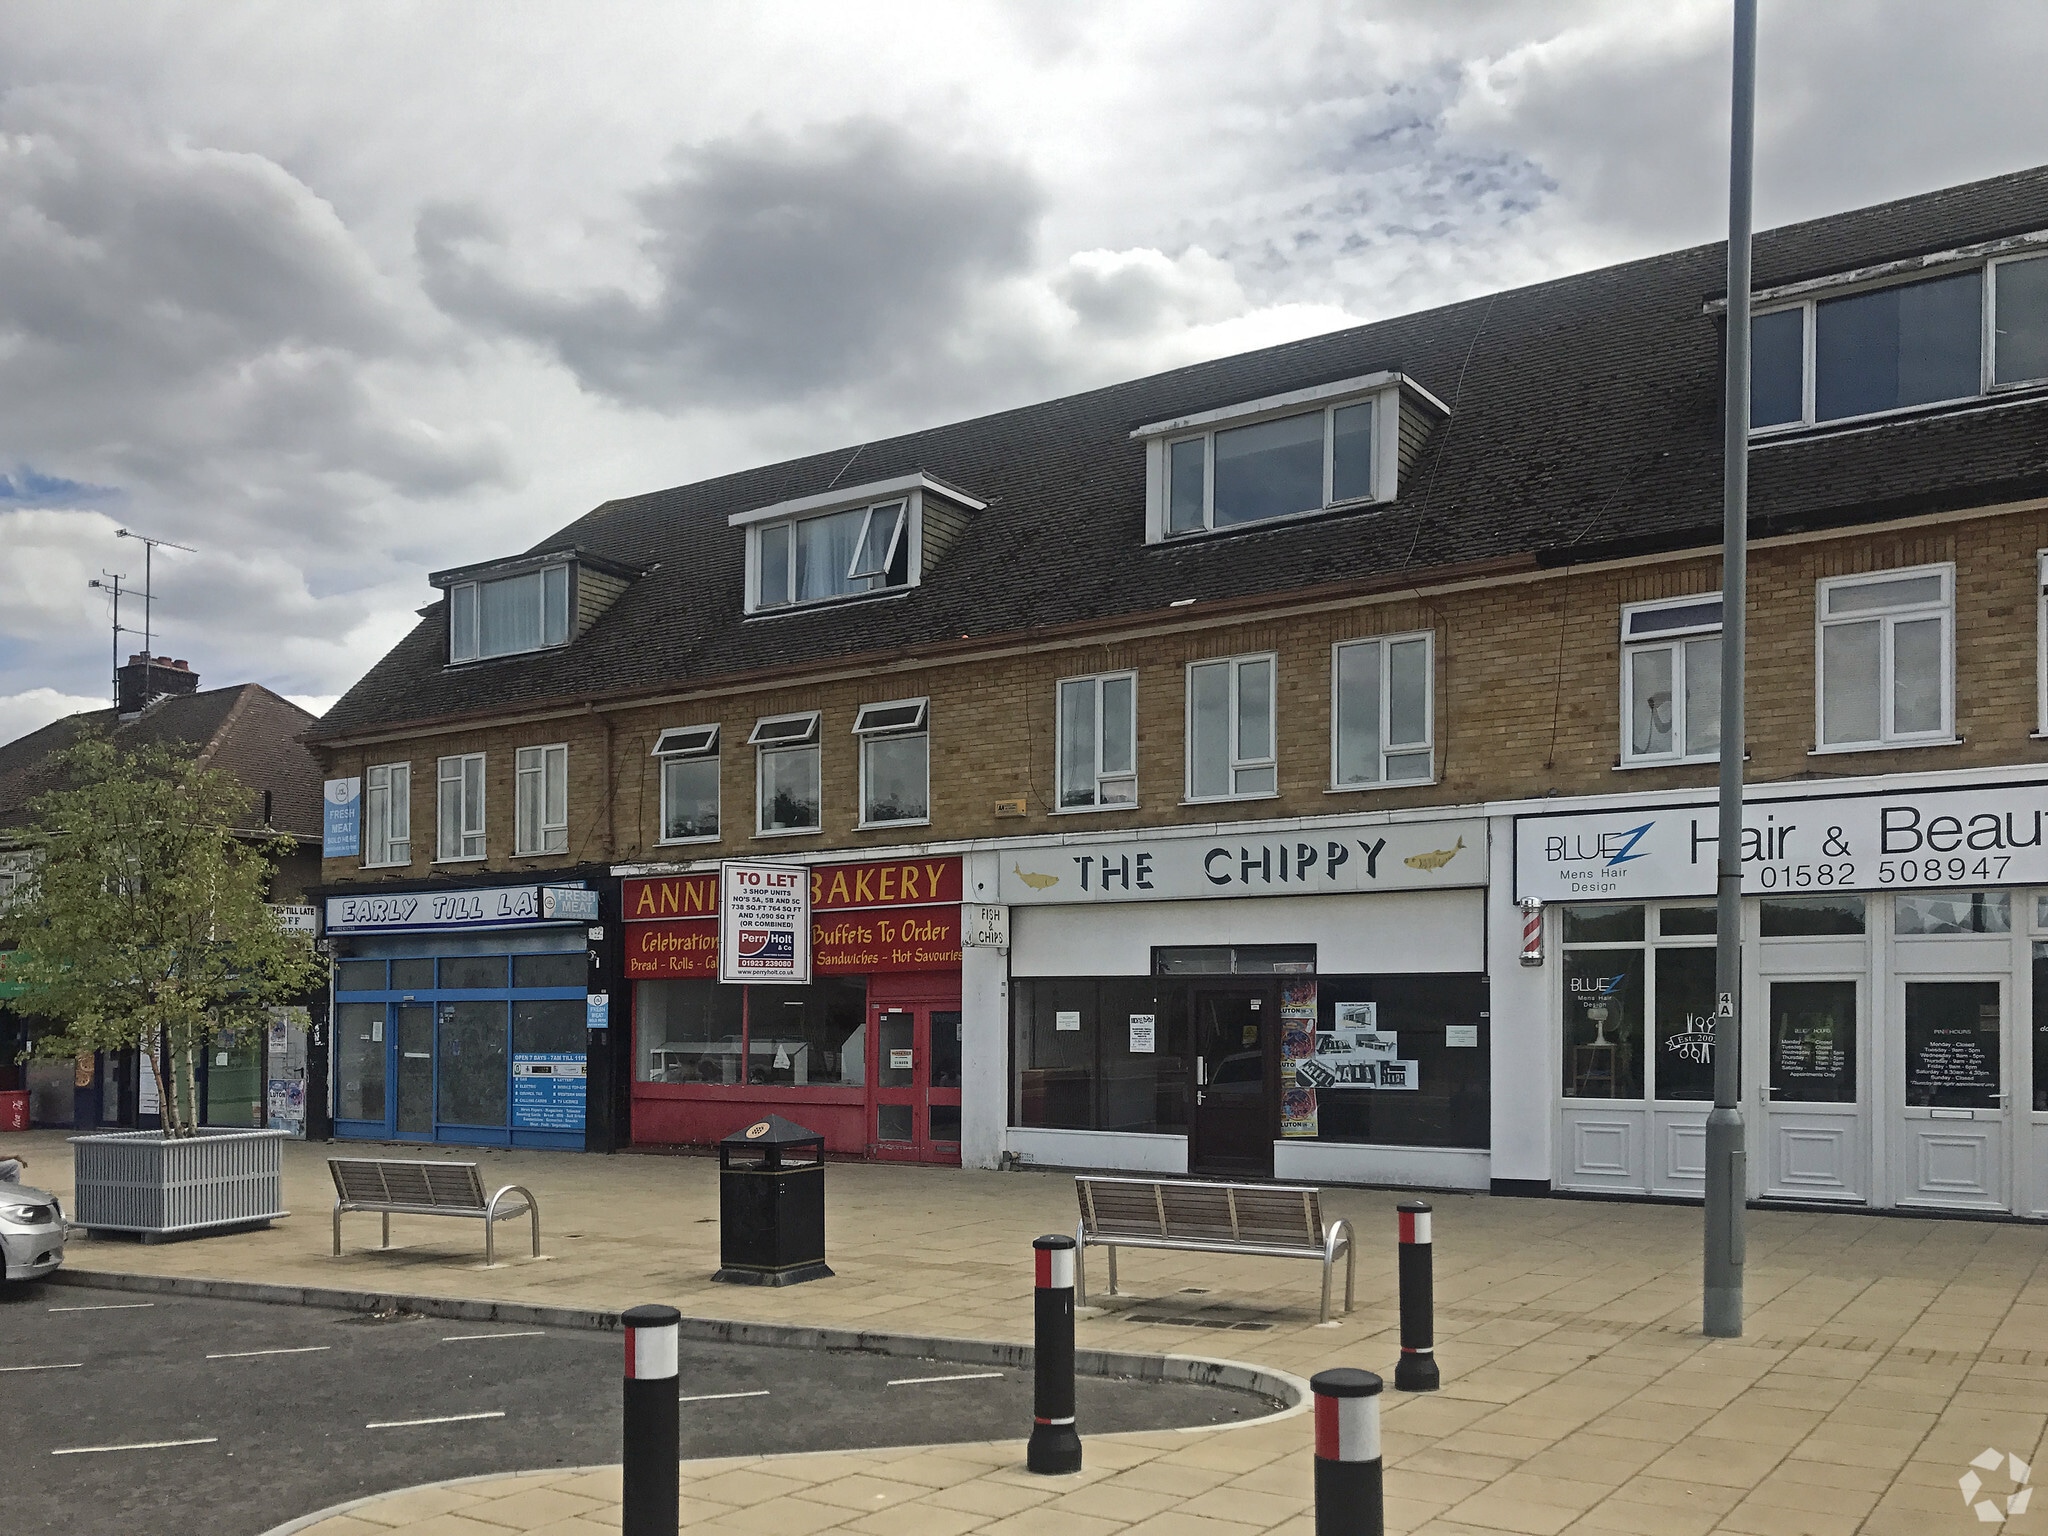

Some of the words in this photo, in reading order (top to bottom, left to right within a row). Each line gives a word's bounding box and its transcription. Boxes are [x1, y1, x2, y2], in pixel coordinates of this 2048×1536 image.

[329, 808, 355, 820] FRESH
[331, 822, 353, 833] MEAT
[1691, 815, 1796, 863] Hair
[1822, 826, 1852, 857] &
[1880, 806, 2048, 854] Beau
[1072, 852, 1154, 891] THE
[1204, 838, 1386, 885] CHIPPY
[1560, 869, 1594, 880] Mens
[1601, 868, 1628, 878] Hair
[1761, 863, 1855, 888] 01582
[1878, 856, 2012, 884] 508947
[736, 872, 761, 886] TO
[766, 874, 798, 887] LET
[636, 880, 716, 915] ANNI
[811, 863, 945, 905] BAKERY
[1571, 882, 1616, 893] Design
[558, 890, 596, 902] FRESH
[286, 907, 299, 915] TILL
[300, 908, 315, 916] LATE
[341, 898, 418, 923] EARLY
[433, 896, 484, 921] TILL
[562, 901, 592, 912] MEAT
[981, 908, 1000, 921] FISH
[754, 921, 794, 929] COMBINED)
[988, 921, 993, 932] &
[812, 924, 873, 945] Buffets
[877, 920, 896, 943] To
[901, 919, 950, 943] Order
[978, 931, 1003, 944] CHIPS
[741, 933, 768, 944] Perry
[770, 934, 793, 944] Holt
[816, 950, 879, 966] Sandwiches
[891, 948, 912, 964] Hot
[914, 947, 963, 963] Savouries
[630, 957, 658, 972] Bread
[669, 956, 694, 970] Rolls
[1720, 993, 1730, 1003] 4
[1720, 1006, 1731, 1015] A
[1697, 1034, 1716, 1043] 200
